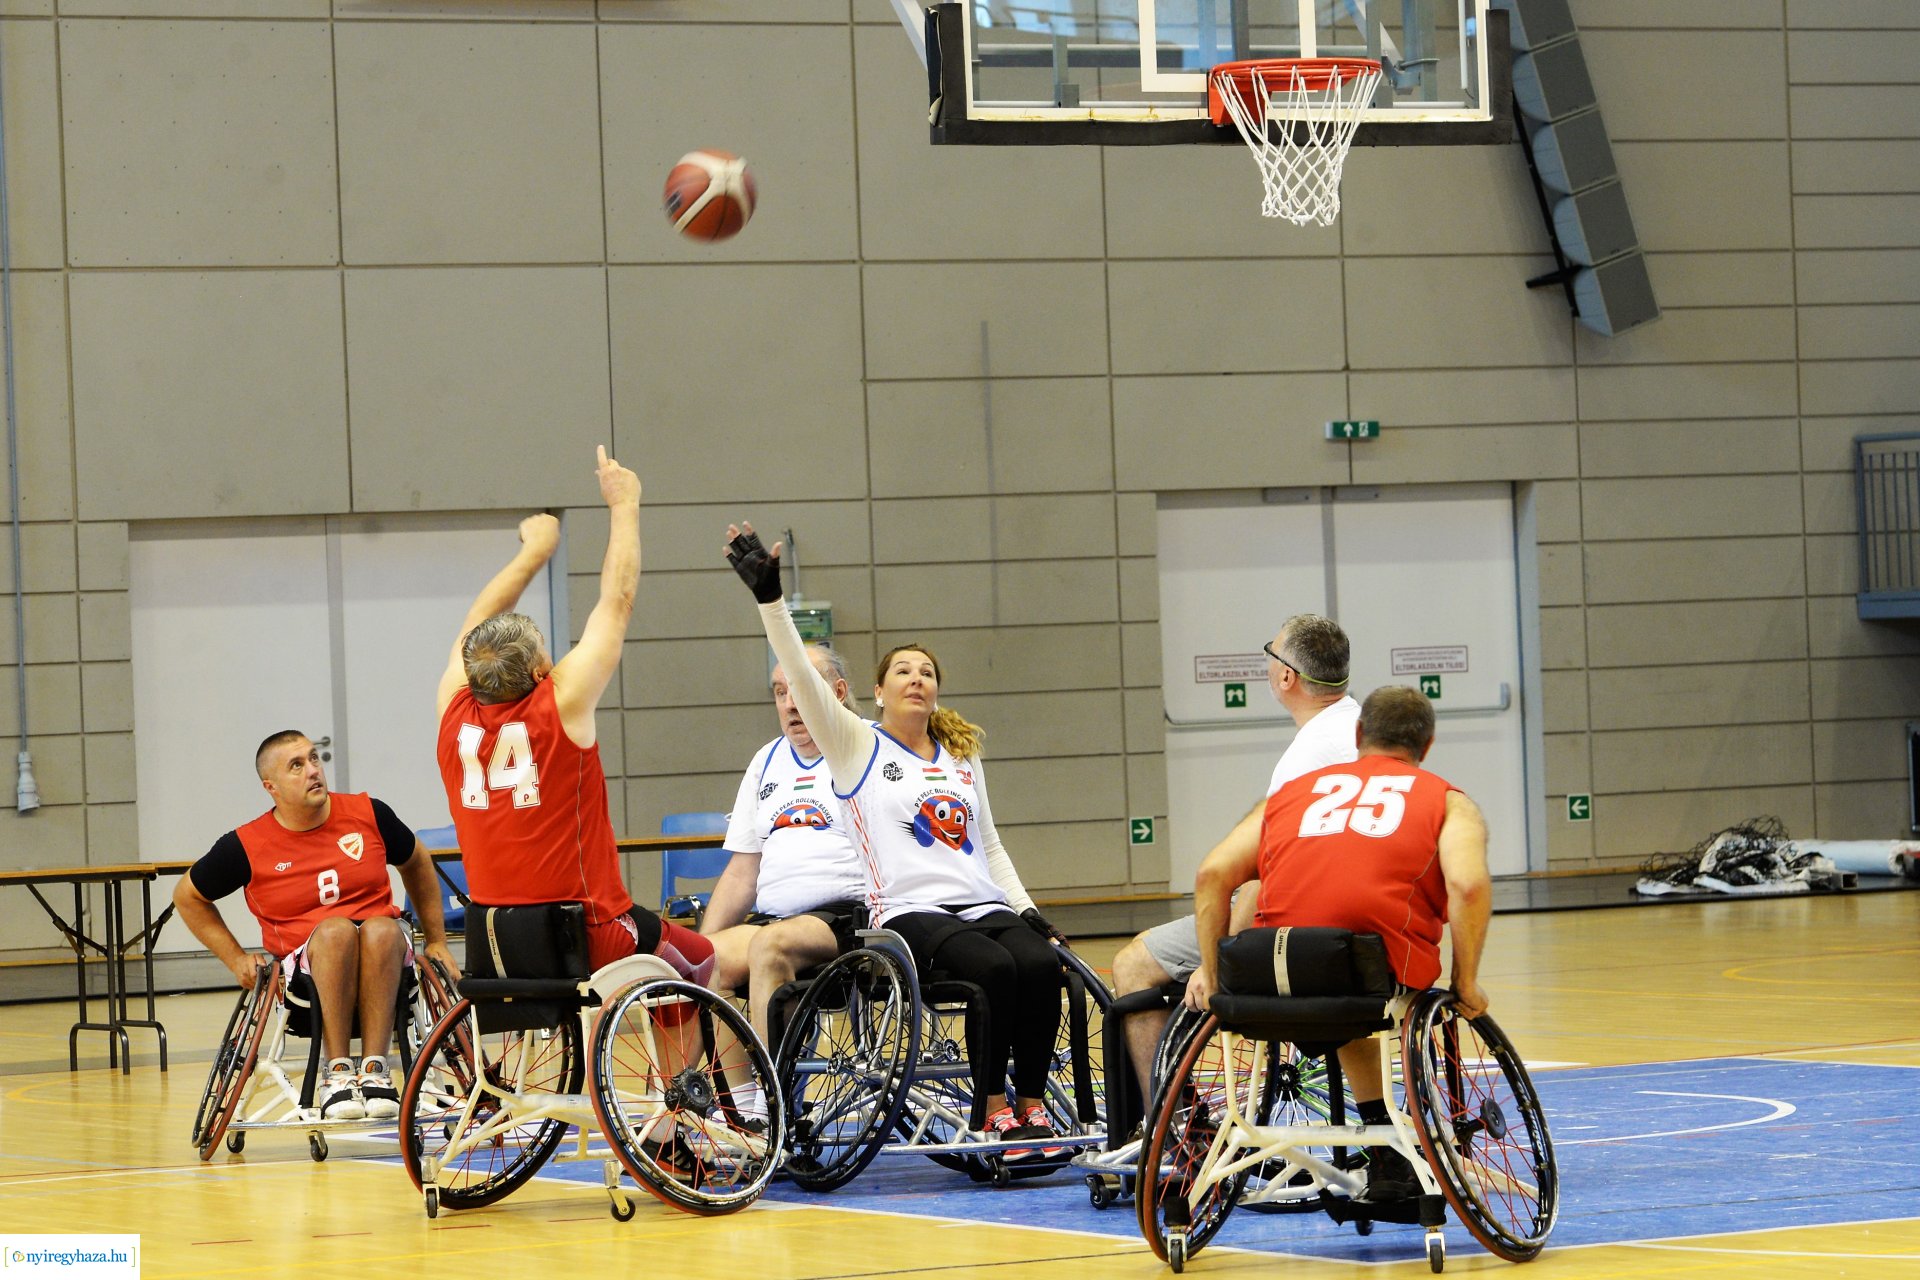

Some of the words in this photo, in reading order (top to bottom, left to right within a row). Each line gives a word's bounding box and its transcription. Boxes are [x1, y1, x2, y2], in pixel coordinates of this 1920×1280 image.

[457, 721, 541, 810] 14
[780, 801, 795, 812] PEAC
[796, 798, 819, 806] ROLLING
[818, 804, 834, 823] BASKET
[962, 798, 974, 821] BASKET
[1298, 773, 1417, 838] 25
[318, 870, 340, 905] 8
